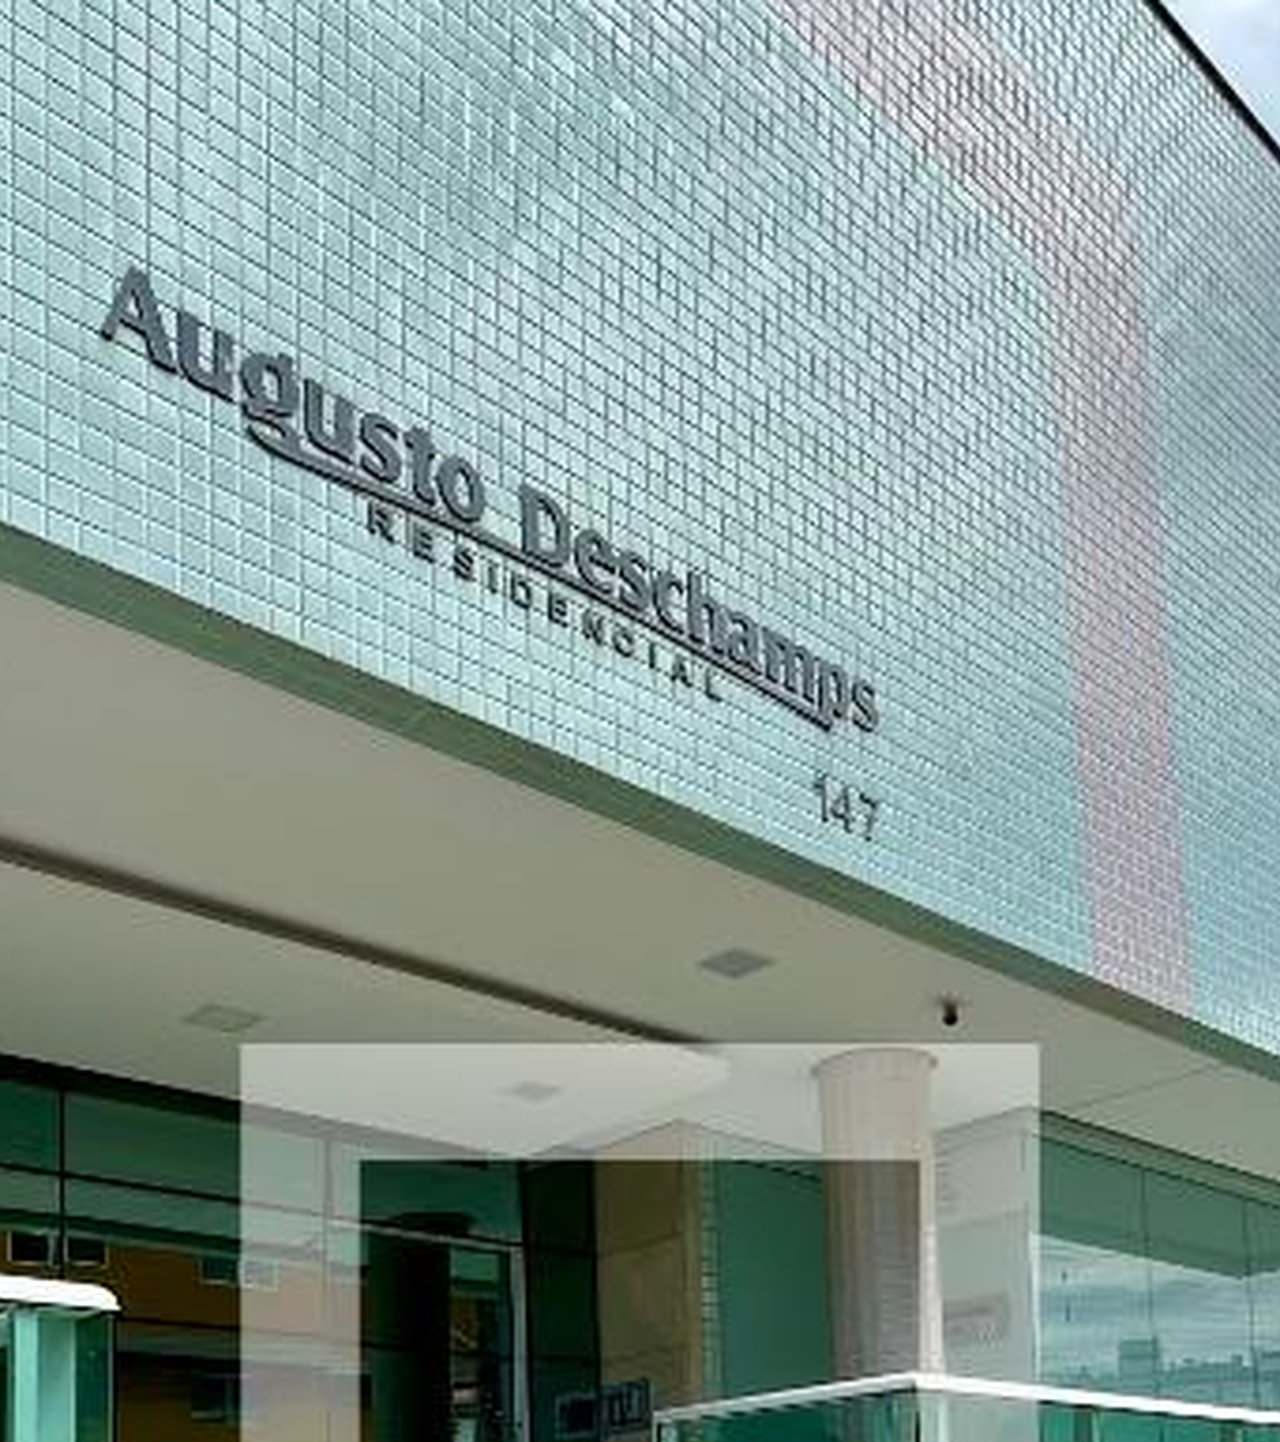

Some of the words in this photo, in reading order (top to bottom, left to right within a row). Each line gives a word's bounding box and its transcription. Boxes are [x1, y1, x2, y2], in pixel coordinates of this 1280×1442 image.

[100, 265, 487, 524] Augusto
[519, 485, 881, 733] Deschamps
[367, 501, 725, 702] RESIDENCIAL
[814, 771, 881, 842] 147
